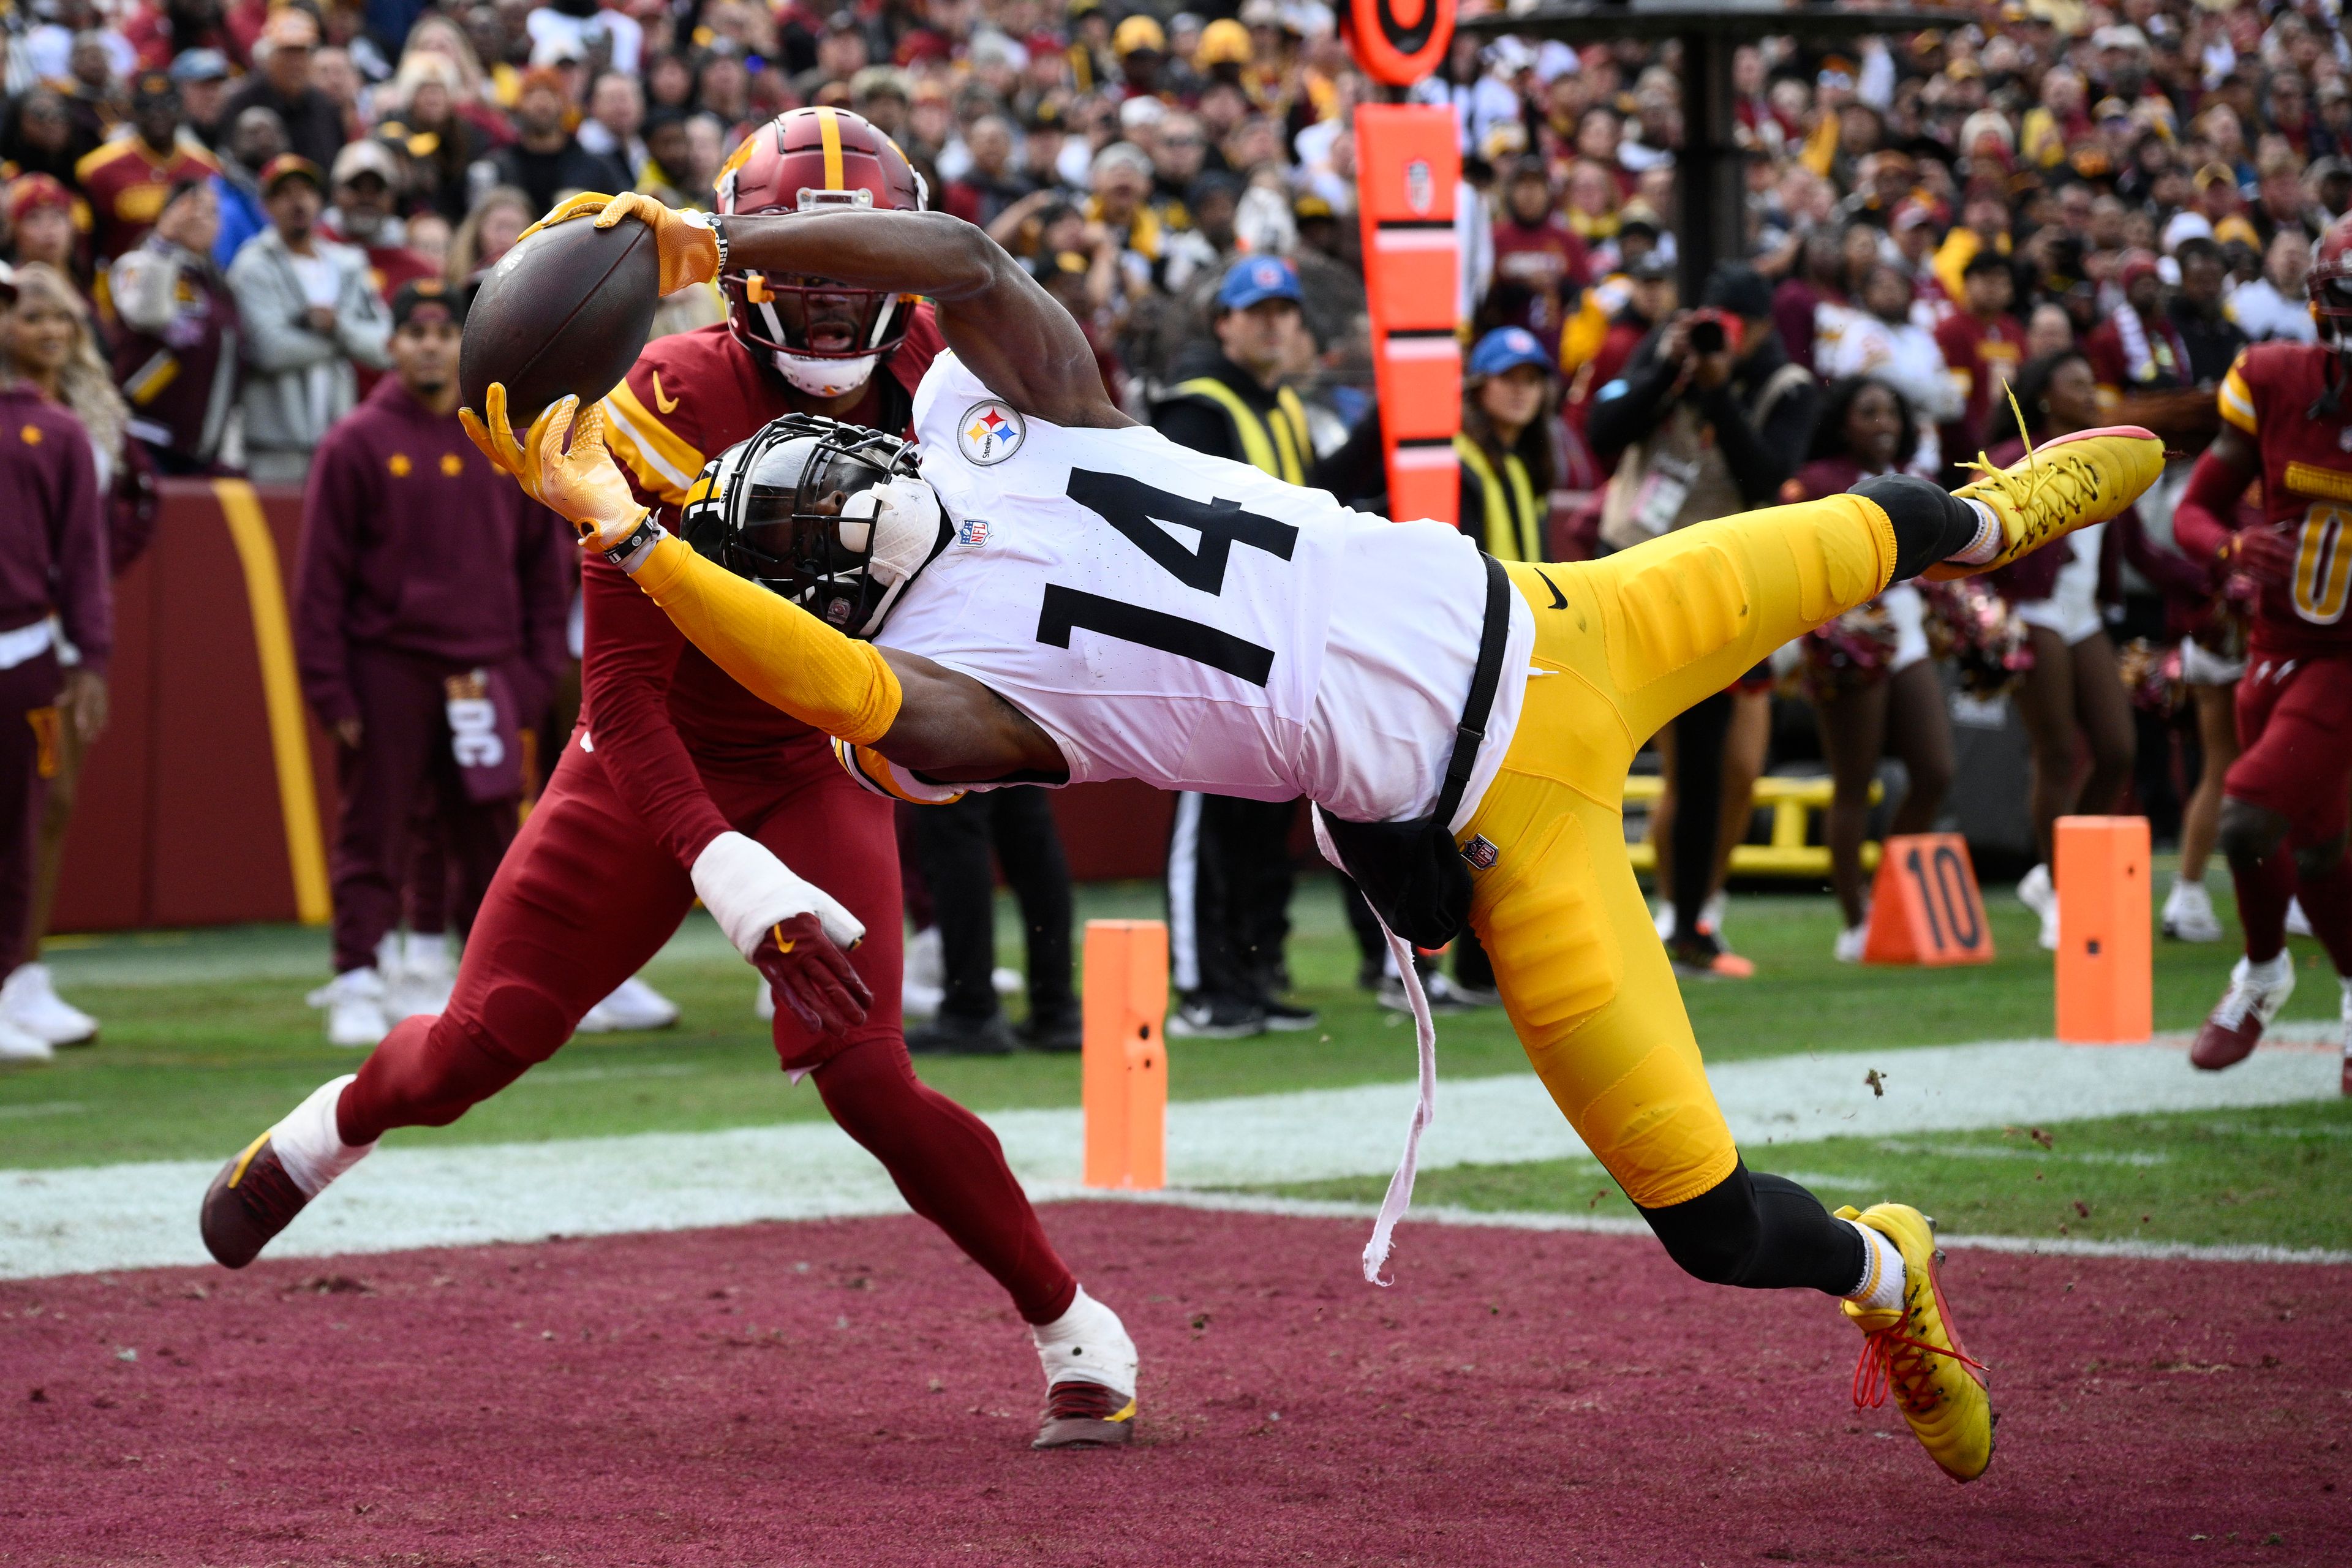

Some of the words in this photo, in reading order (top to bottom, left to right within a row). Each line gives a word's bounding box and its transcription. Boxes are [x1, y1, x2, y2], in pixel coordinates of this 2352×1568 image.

[982, 434, 993, 459] Steelers
[970, 524, 986, 543] NFL
[1036, 467, 1300, 688] 14
[1472, 846, 1494, 866] NFL
[1907, 846, 1980, 951] 10
